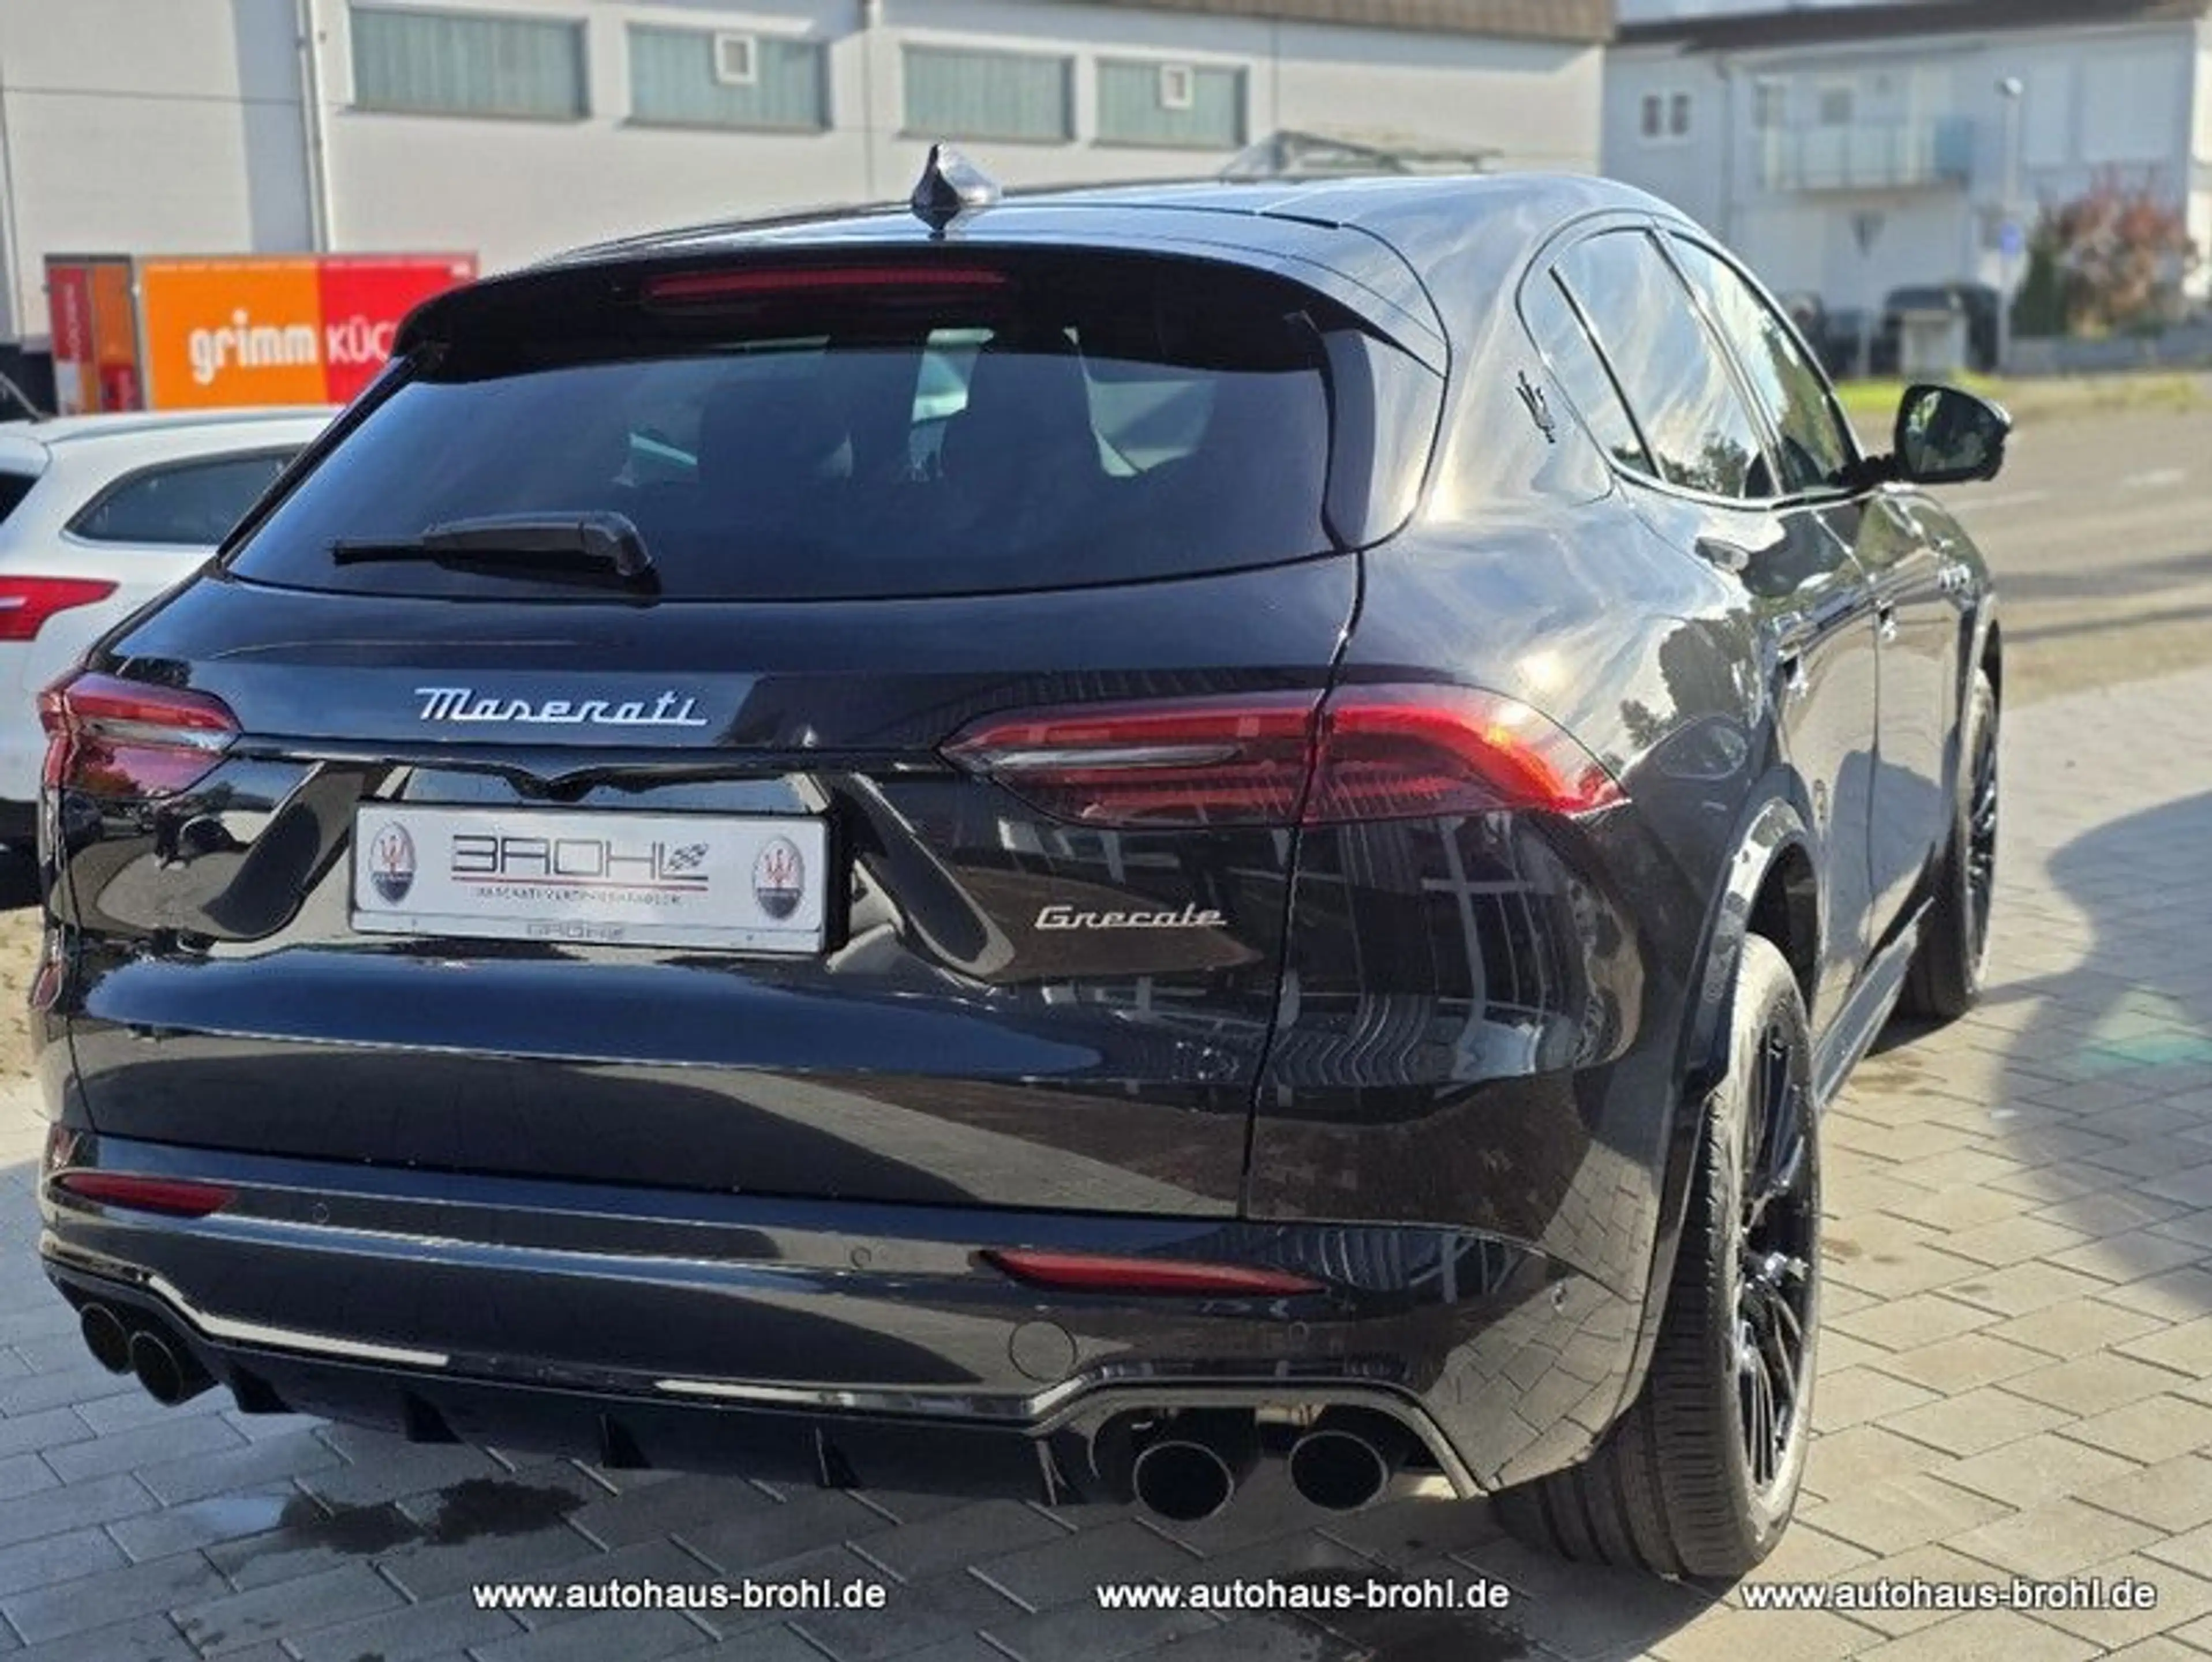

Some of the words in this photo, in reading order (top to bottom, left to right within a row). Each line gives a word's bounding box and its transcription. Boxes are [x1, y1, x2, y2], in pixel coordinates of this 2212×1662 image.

[189, 309, 318, 385] grimm
[414, 688, 708, 725] Maserati
[1035, 901, 1227, 930] Grecale
